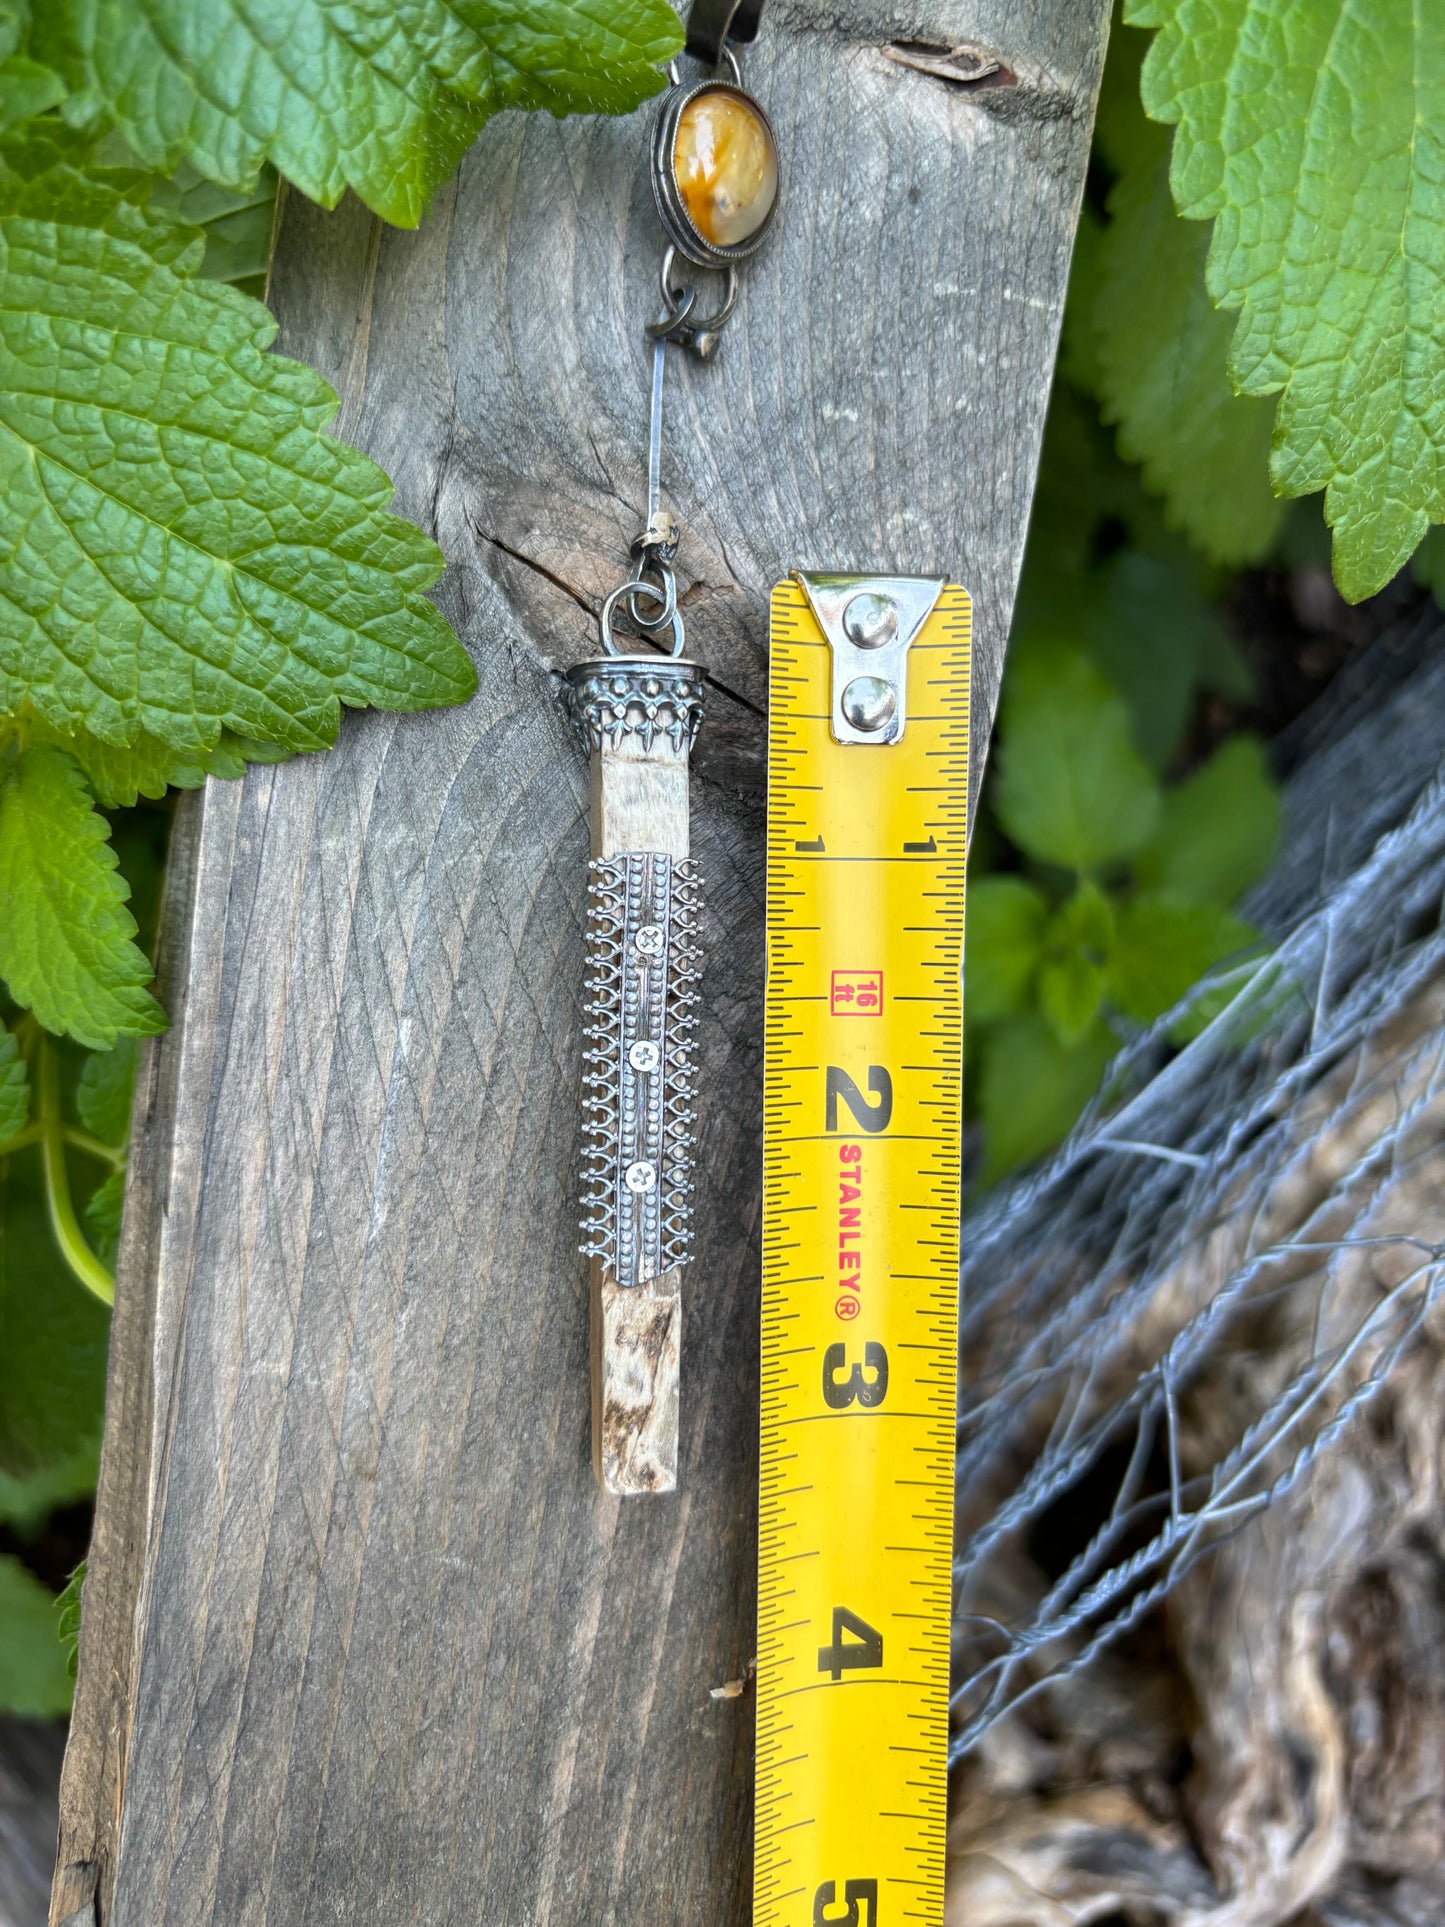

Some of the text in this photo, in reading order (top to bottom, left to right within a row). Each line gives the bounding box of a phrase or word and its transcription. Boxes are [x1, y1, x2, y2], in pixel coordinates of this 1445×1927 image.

[795, 835, 826, 852] 1
[903, 835, 938, 853] 1
[834, 984, 855, 1003] ft
[856, 980, 878, 1007] 16
[825, 1065, 893, 1133] 2
[822, 1341, 889, 1410] 3
[818, 1605, 883, 1681] 4
[812, 1878, 878, 1927] 5
